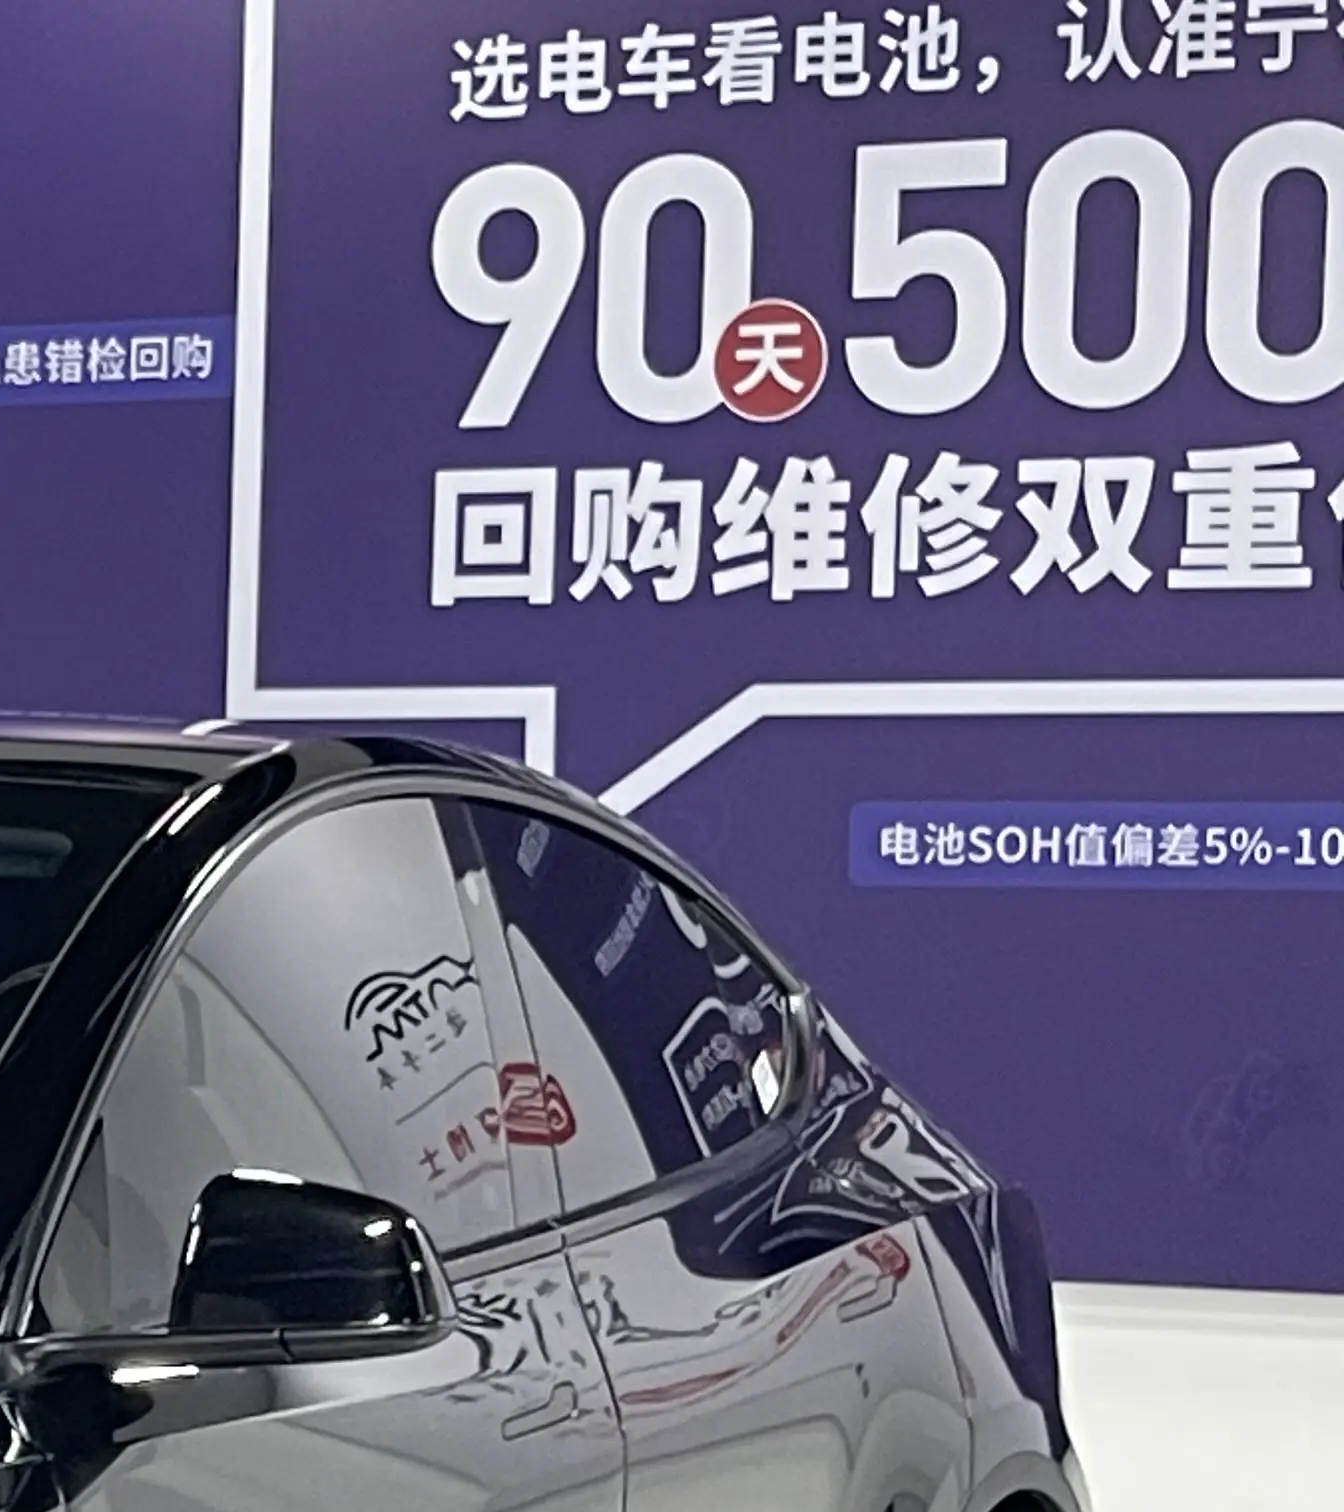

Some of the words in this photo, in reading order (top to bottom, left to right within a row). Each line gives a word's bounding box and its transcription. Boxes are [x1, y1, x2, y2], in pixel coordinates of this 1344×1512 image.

[451, 0, 1344, 121] 选电车看电池，认准宁
[431, 153, 755, 428] 90
[735, 317, 806, 394] 天
[430, 441, 1344, 606] 回购维修双重
